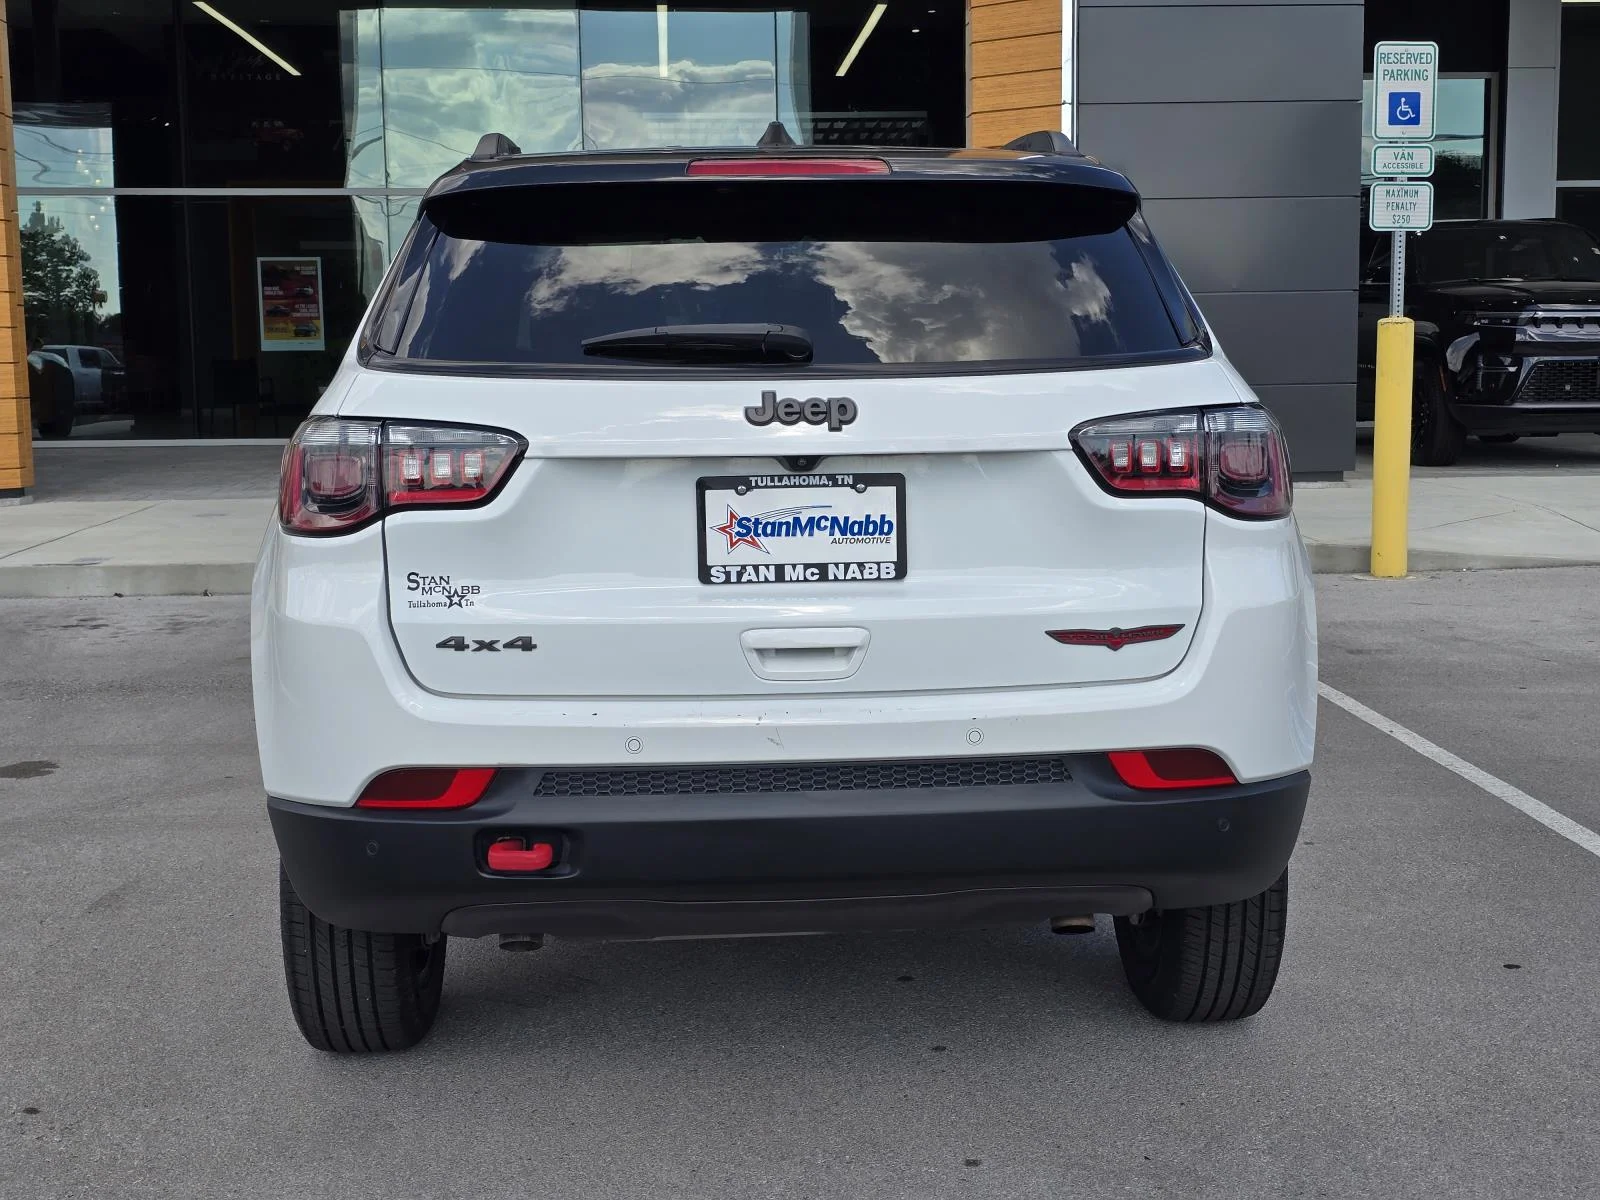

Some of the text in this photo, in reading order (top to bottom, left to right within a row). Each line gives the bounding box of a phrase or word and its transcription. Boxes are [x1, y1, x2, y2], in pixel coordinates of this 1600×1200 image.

[1379, 52, 1433, 65] RESERVED
[1382, 69, 1429, 82] PARKING
[1393, 151, 1414, 161] VAN
[1382, 162, 1424, 170] ACCESSIBLE
[1385, 189, 1419, 199] MAXIMUM
[1386, 202, 1417, 211] PENALTY
[1392, 214, 1411, 224] $250
[744, 389, 858, 432] Jeep
[749, 475, 853, 487] TULLAHOMA, TN
[830, 537, 892, 545] AUTOMOTIVE
[710, 562, 896, 583] STAN Mc NABB
[407, 598, 475, 608] Tullahoma Tn
[435, 635, 538, 652] 4x4
